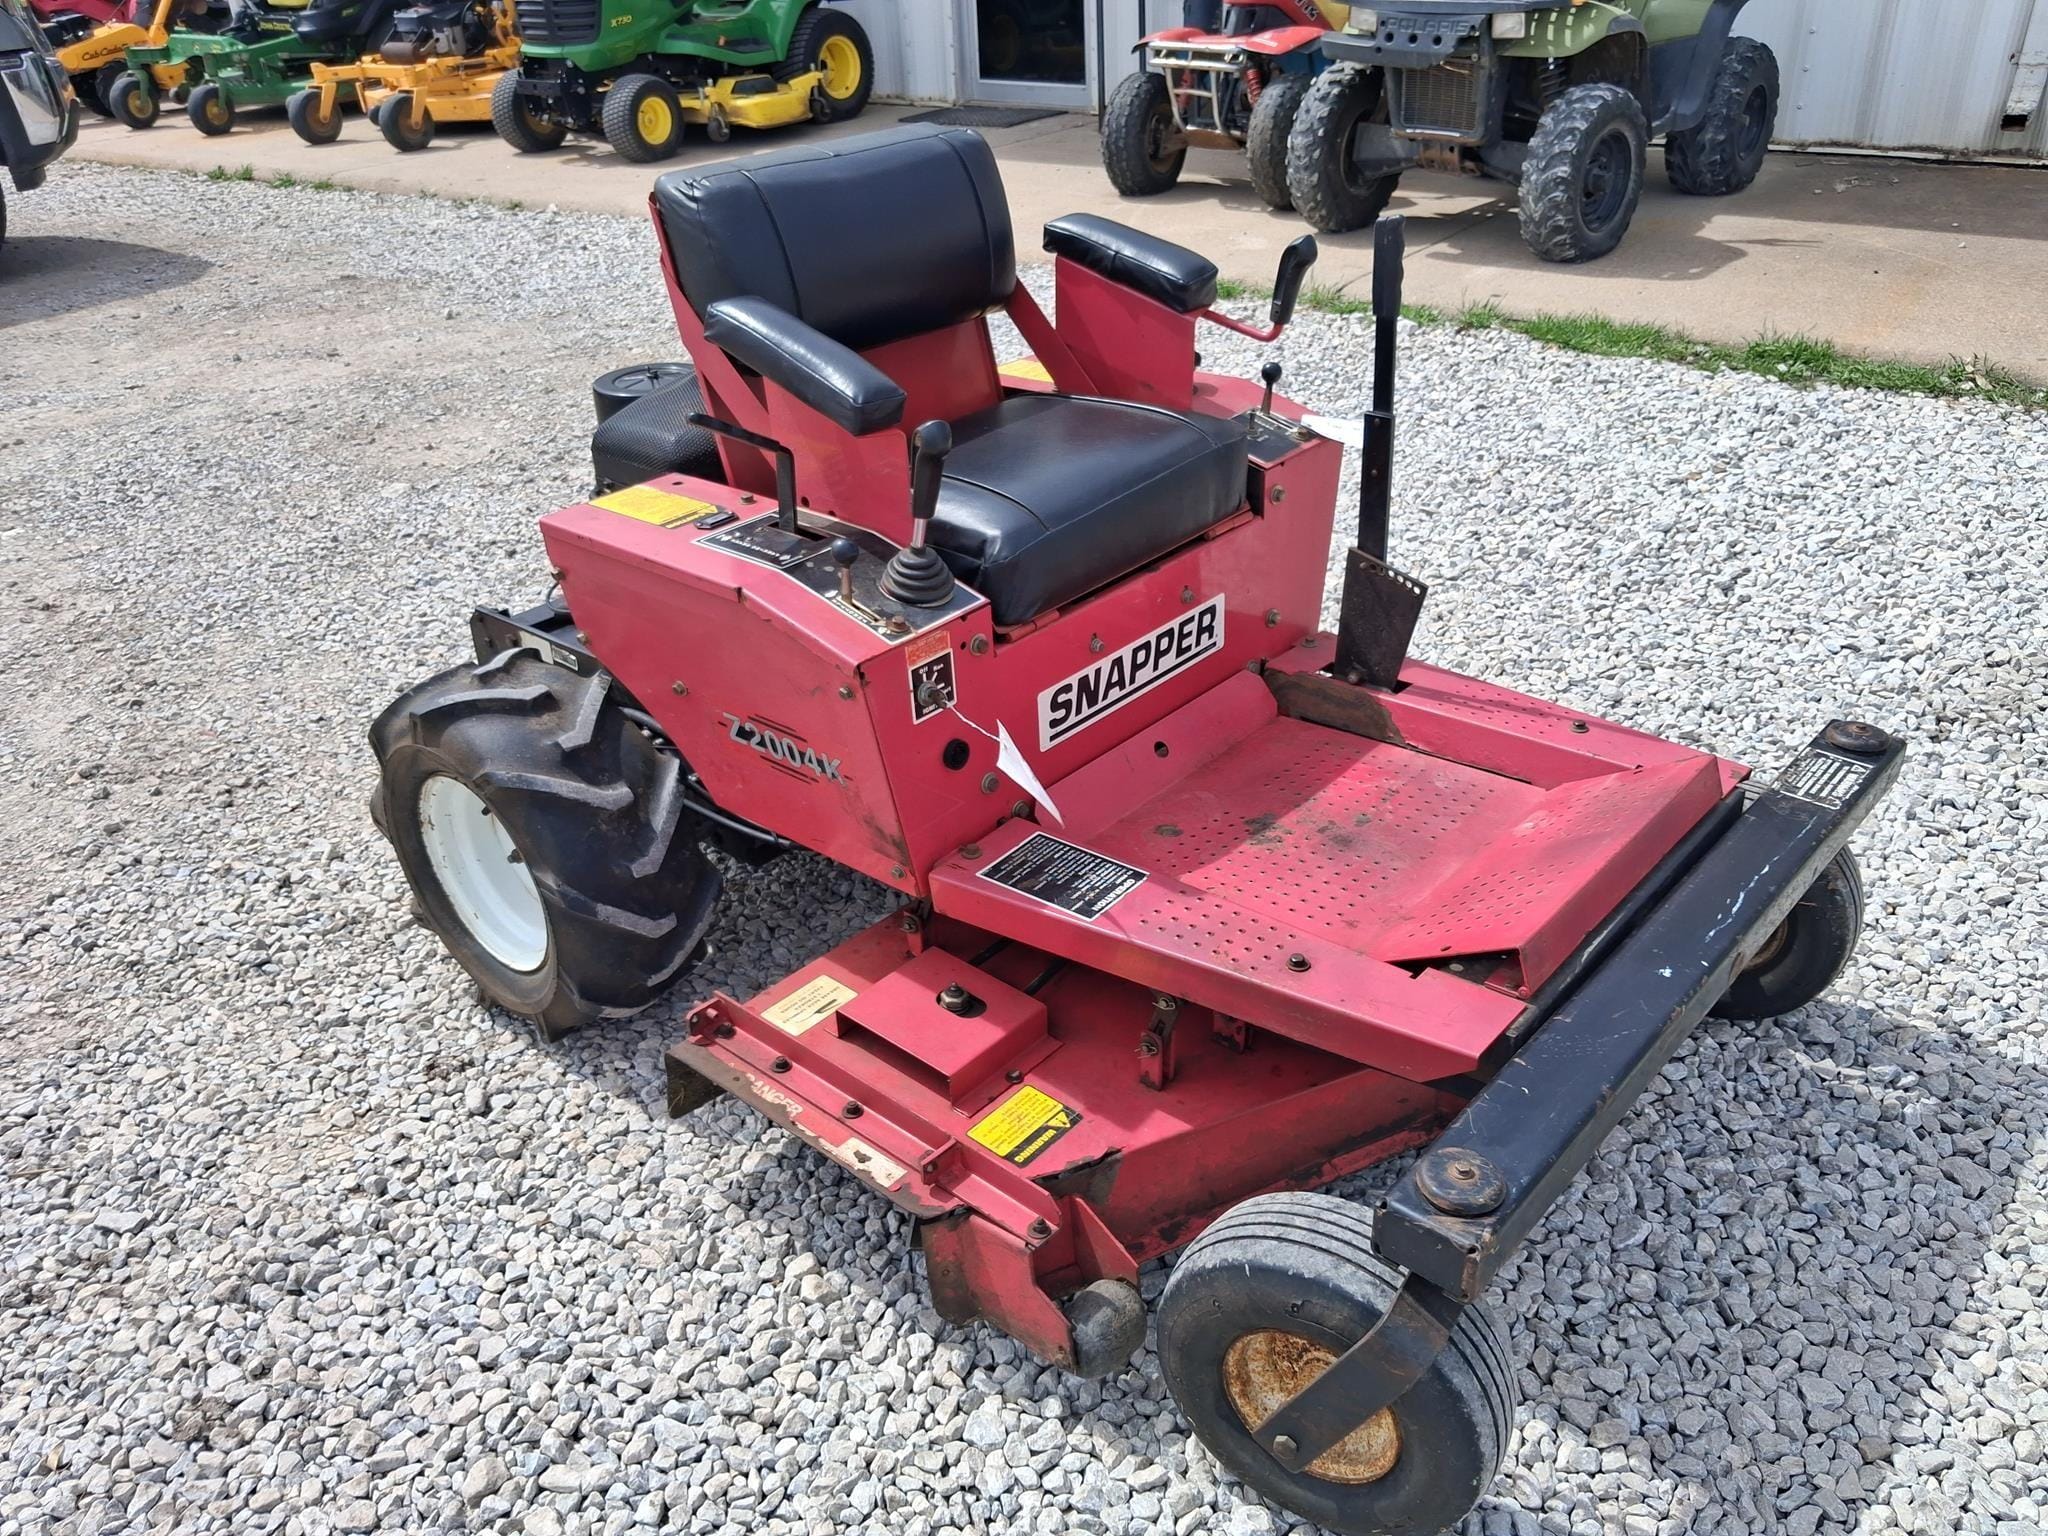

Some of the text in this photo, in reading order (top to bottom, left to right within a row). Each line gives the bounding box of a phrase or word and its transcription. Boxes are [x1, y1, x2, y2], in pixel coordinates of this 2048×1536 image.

[610, 15, 633, 28] X730
[1385, 16, 1472, 35] POLARIS
[82, 51, 99, 61] Cub
[1049, 604, 1217, 729] SNAPPER
[1090, 877, 1136, 911] OPERATION
[1014, 1128, 1057, 1163] WARNING
